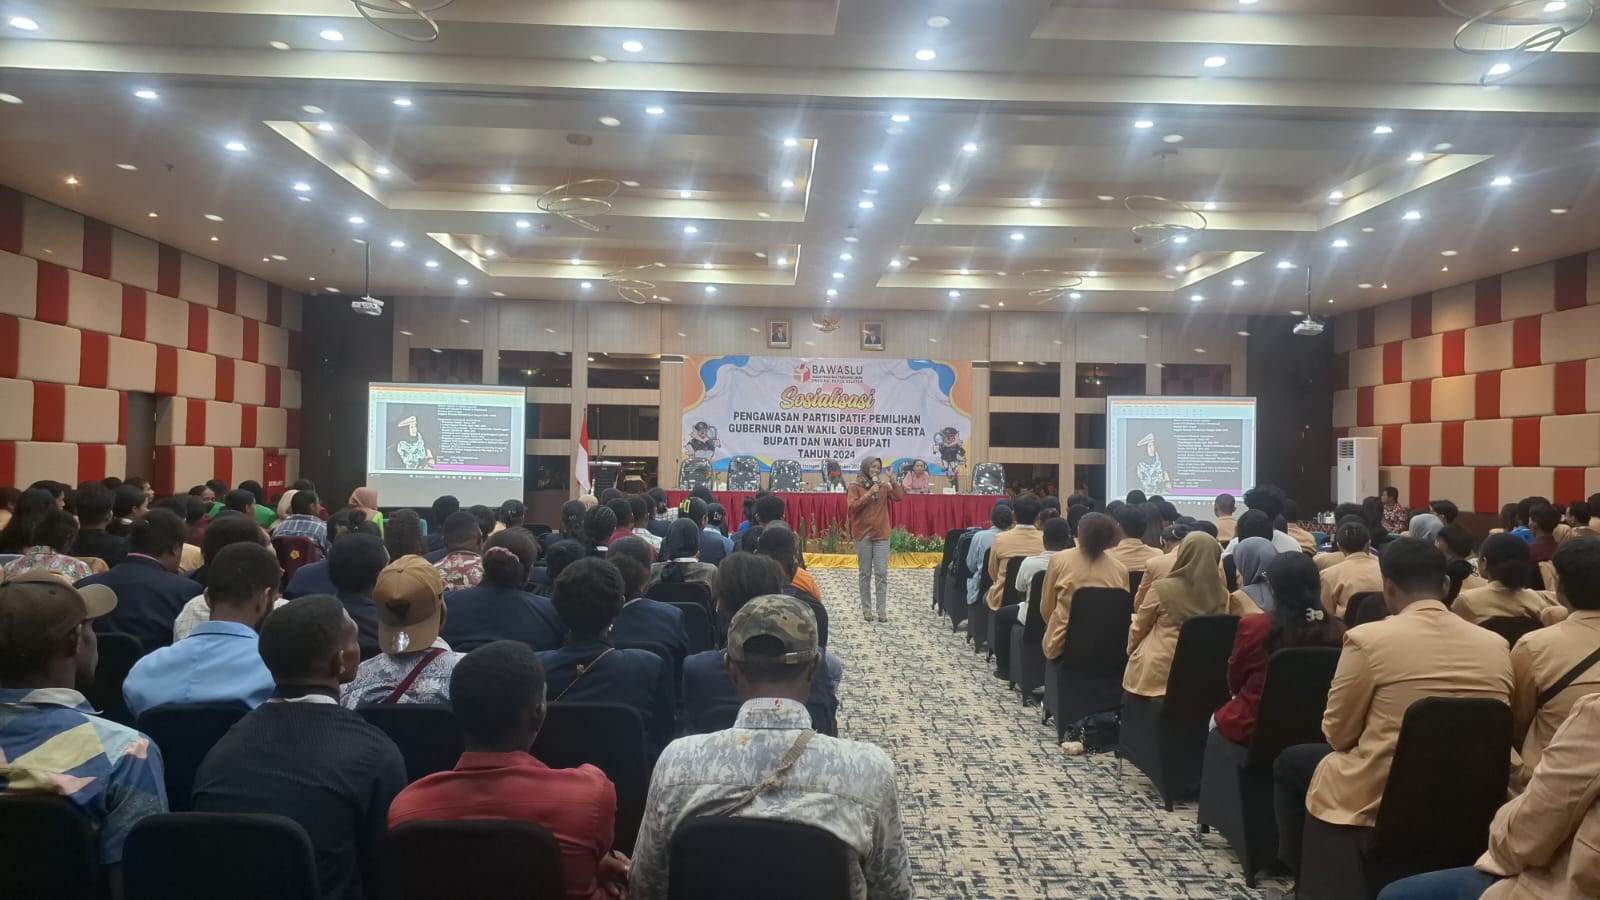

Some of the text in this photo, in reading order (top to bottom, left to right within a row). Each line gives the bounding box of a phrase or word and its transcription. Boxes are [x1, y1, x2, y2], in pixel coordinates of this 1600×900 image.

[812, 365, 863, 374] BAWASLU
[780, 385, 876, 409] Sosialisasi
[733, 411, 921, 424] PENGAWASAN PARTISIPATIF PEMILIHAN
[728, 423, 926, 436] GUBERNUR DAN WAKIL GUBERNUR SERTA
[763, 436, 891, 447] BUPATI DAN WAKIL BUPATI
[798, 449, 856, 459] TAHUN 2024
